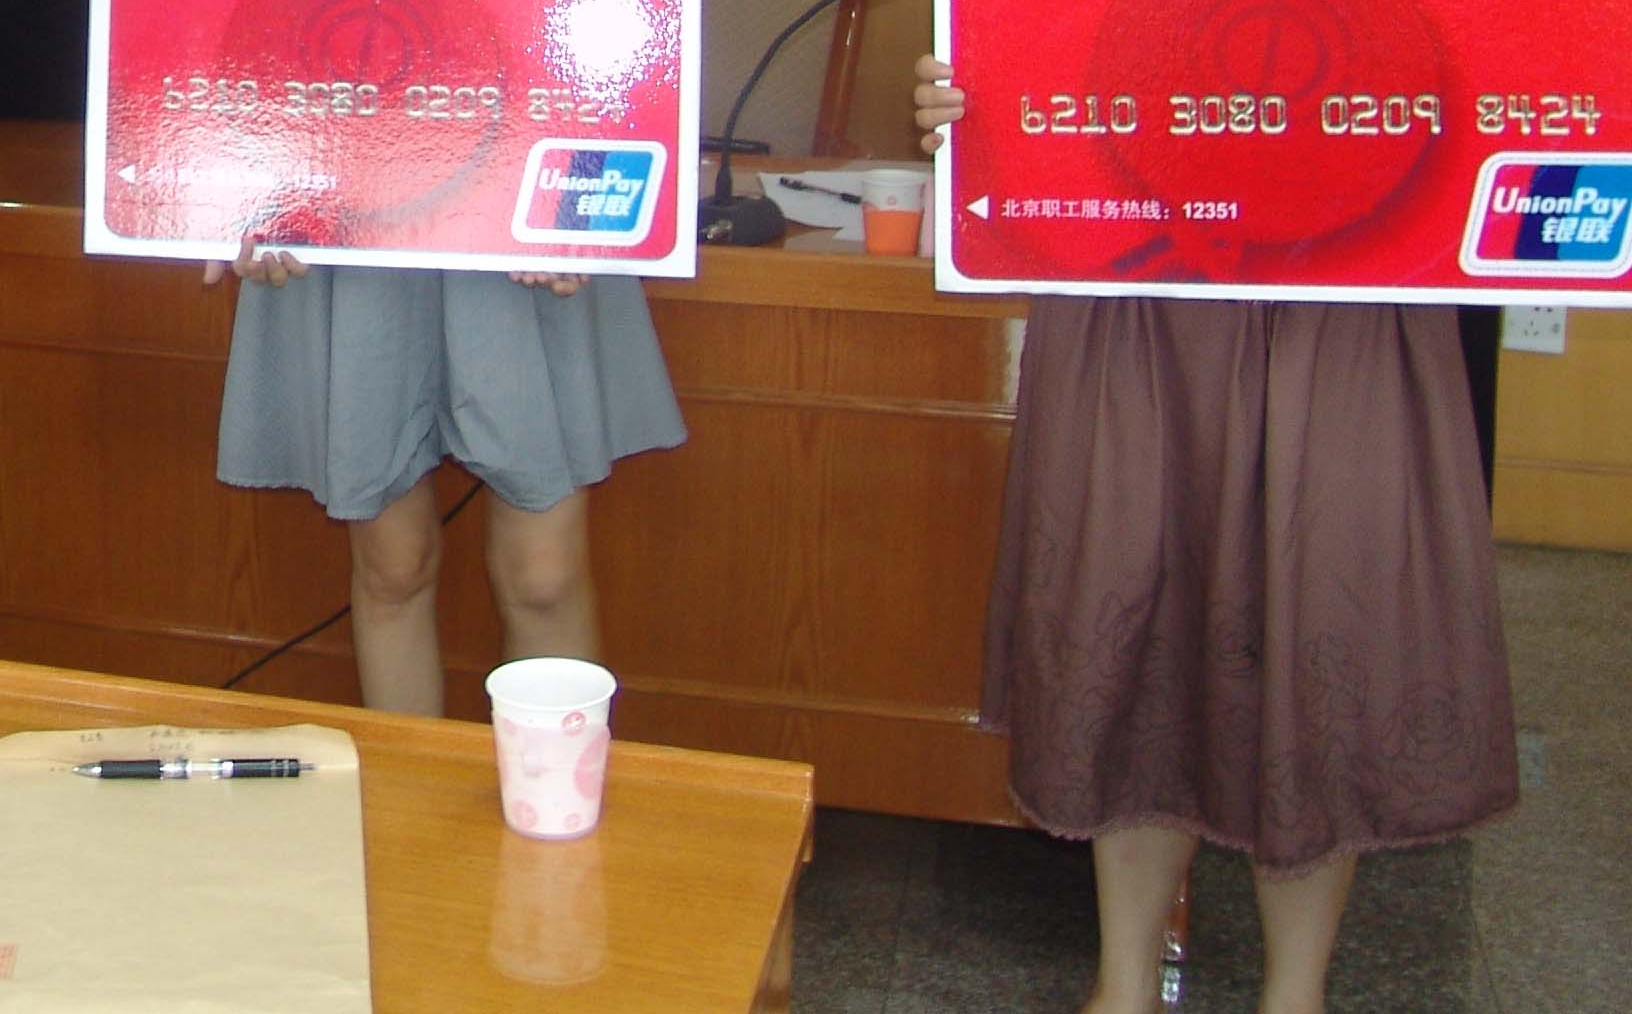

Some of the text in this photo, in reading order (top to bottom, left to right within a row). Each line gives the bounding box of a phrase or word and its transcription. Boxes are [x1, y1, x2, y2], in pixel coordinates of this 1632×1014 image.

[165, 77, 258, 116] 6210
[285, 81, 379, 118] 3080
[405, 85, 501, 121] 0209
[1020, 95, 1602, 135] 6210 3080 0209 8424
[541, 166, 644, 198] UnionPay
[1182, 201, 1239, 221] 12351
[1493, 186, 1628, 223] UnionPay
[1541, 216, 1614, 244] 银联
